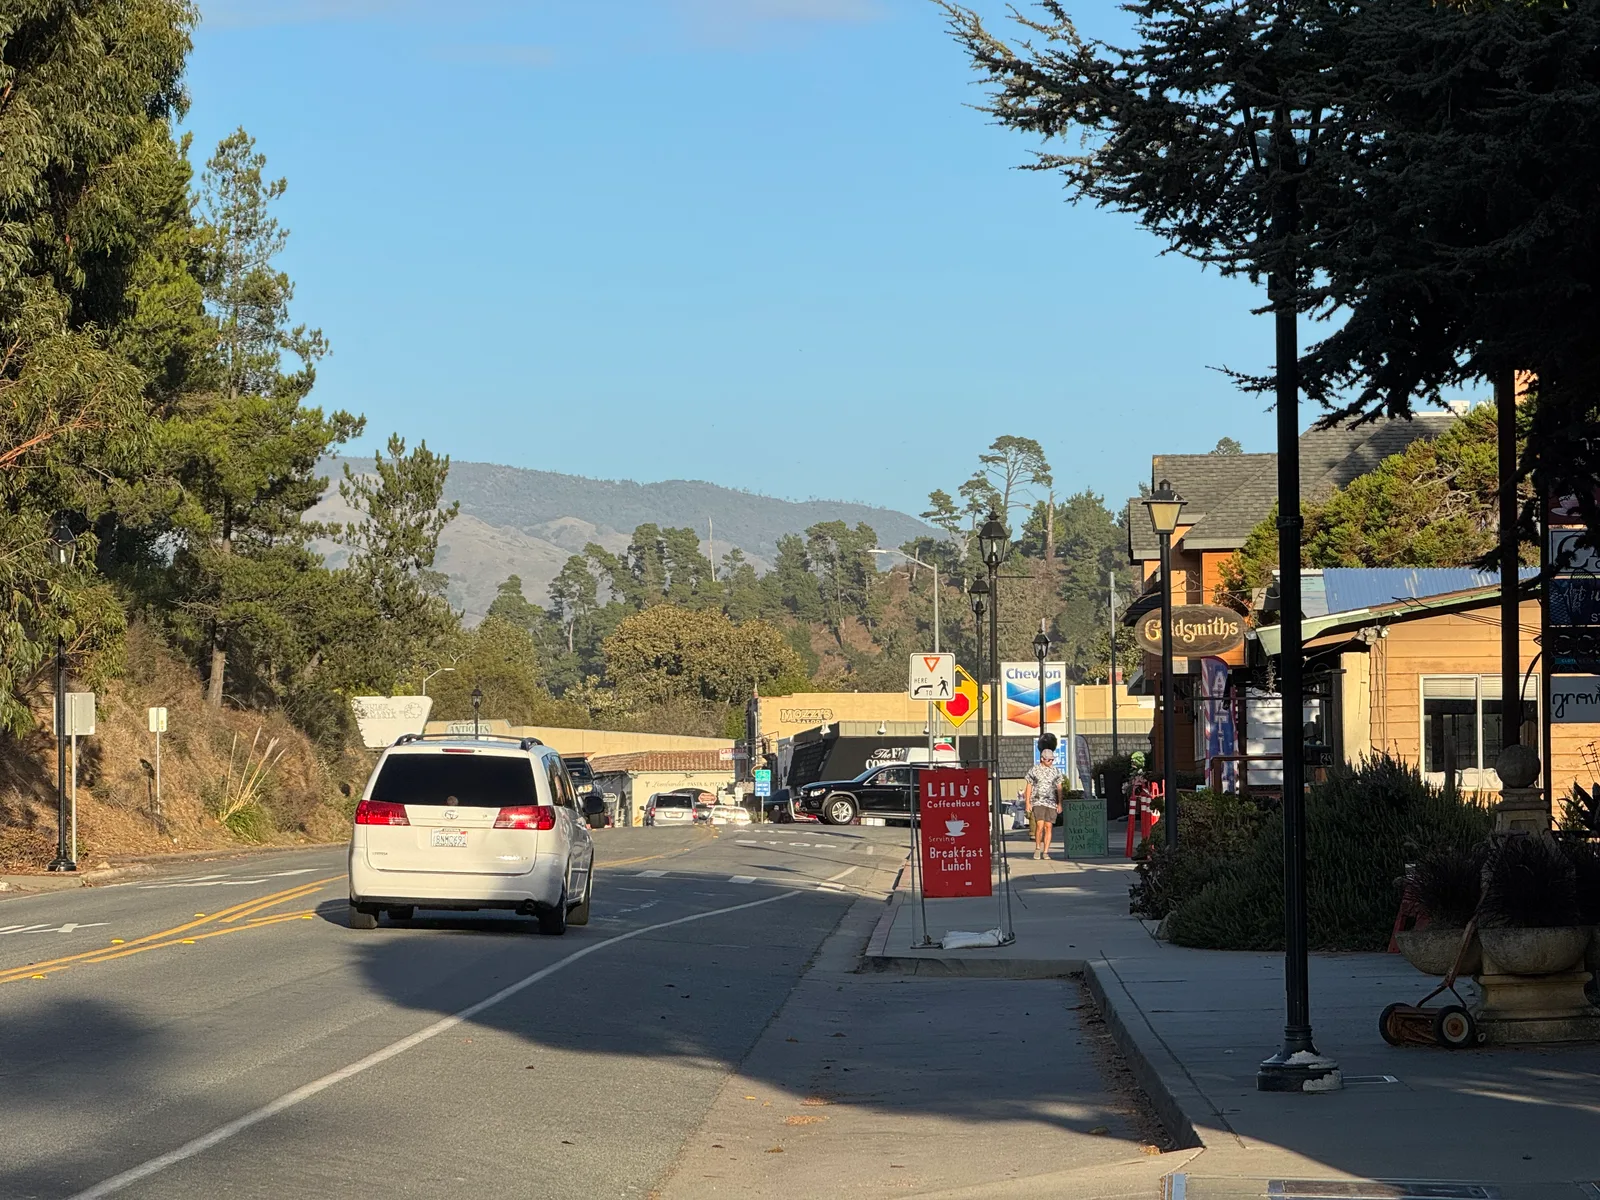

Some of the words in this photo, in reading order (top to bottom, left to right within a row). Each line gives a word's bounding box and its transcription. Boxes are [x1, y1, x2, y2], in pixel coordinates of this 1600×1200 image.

[1144, 616, 1239, 643] Gldsmiths
[1006, 668, 1061, 680] Chevon
[450, 724, 490, 734] ANTIQES
[871, 748, 891, 759] The
[927, 778, 980, 798] Lily's
[1071, 817, 1098, 826] OPEN
[735, 840, 837, 848] STOP
[928, 836, 956, 844] Serving
[929, 846, 983, 859] Breakfast
[941, 858, 971, 871] Lunch
